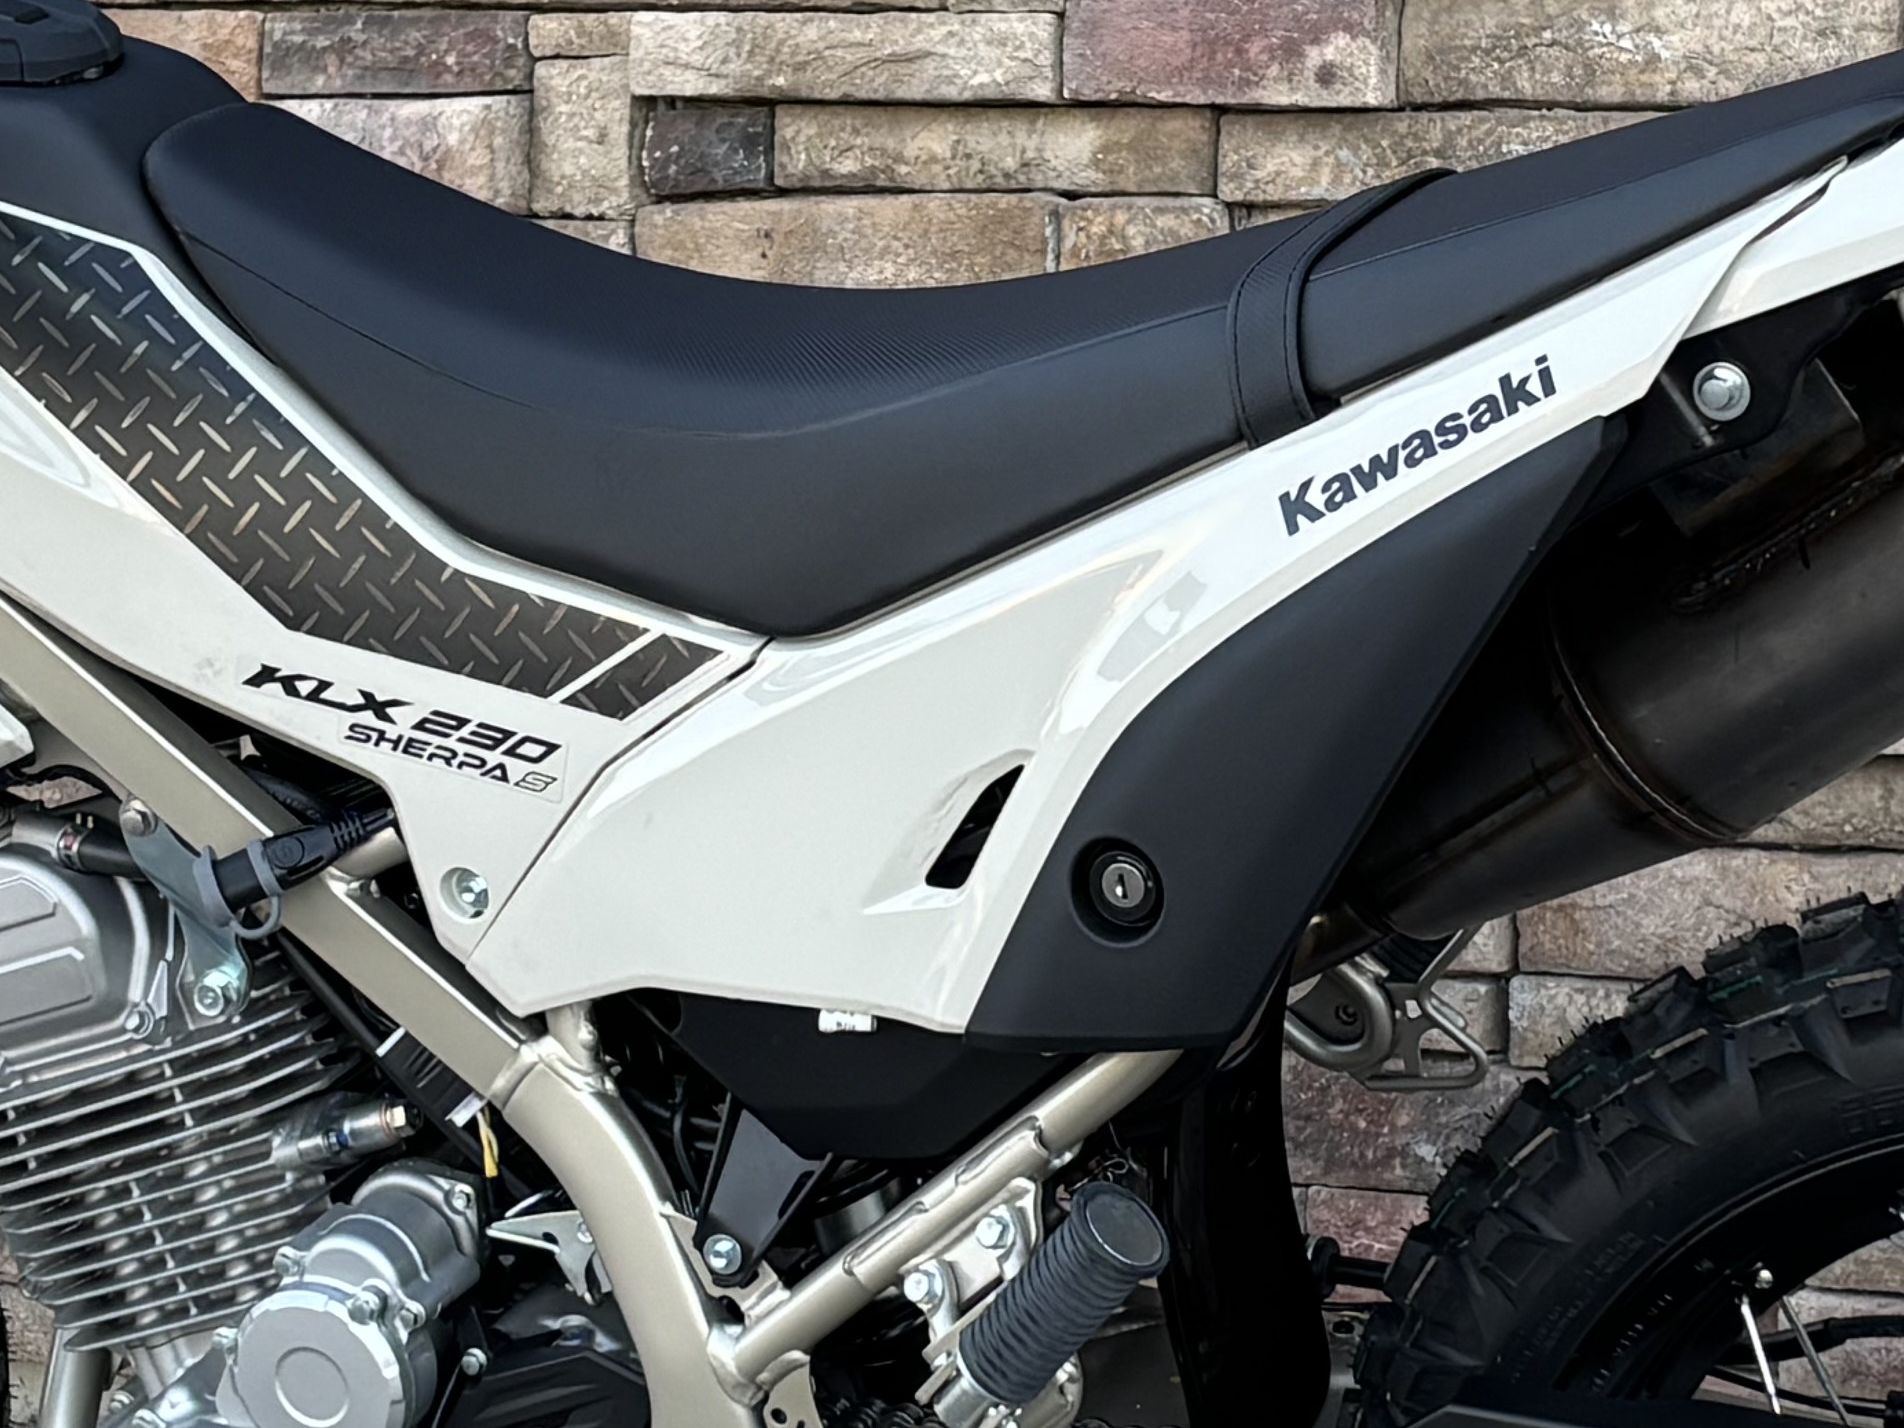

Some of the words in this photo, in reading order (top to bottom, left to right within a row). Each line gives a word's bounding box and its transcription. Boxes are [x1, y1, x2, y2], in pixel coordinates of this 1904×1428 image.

[1278, 354, 1557, 537] Kawasaki
[241, 663, 415, 725] KLX
[410, 709, 563, 764] 230
[344, 723, 510, 785] SHERPA
